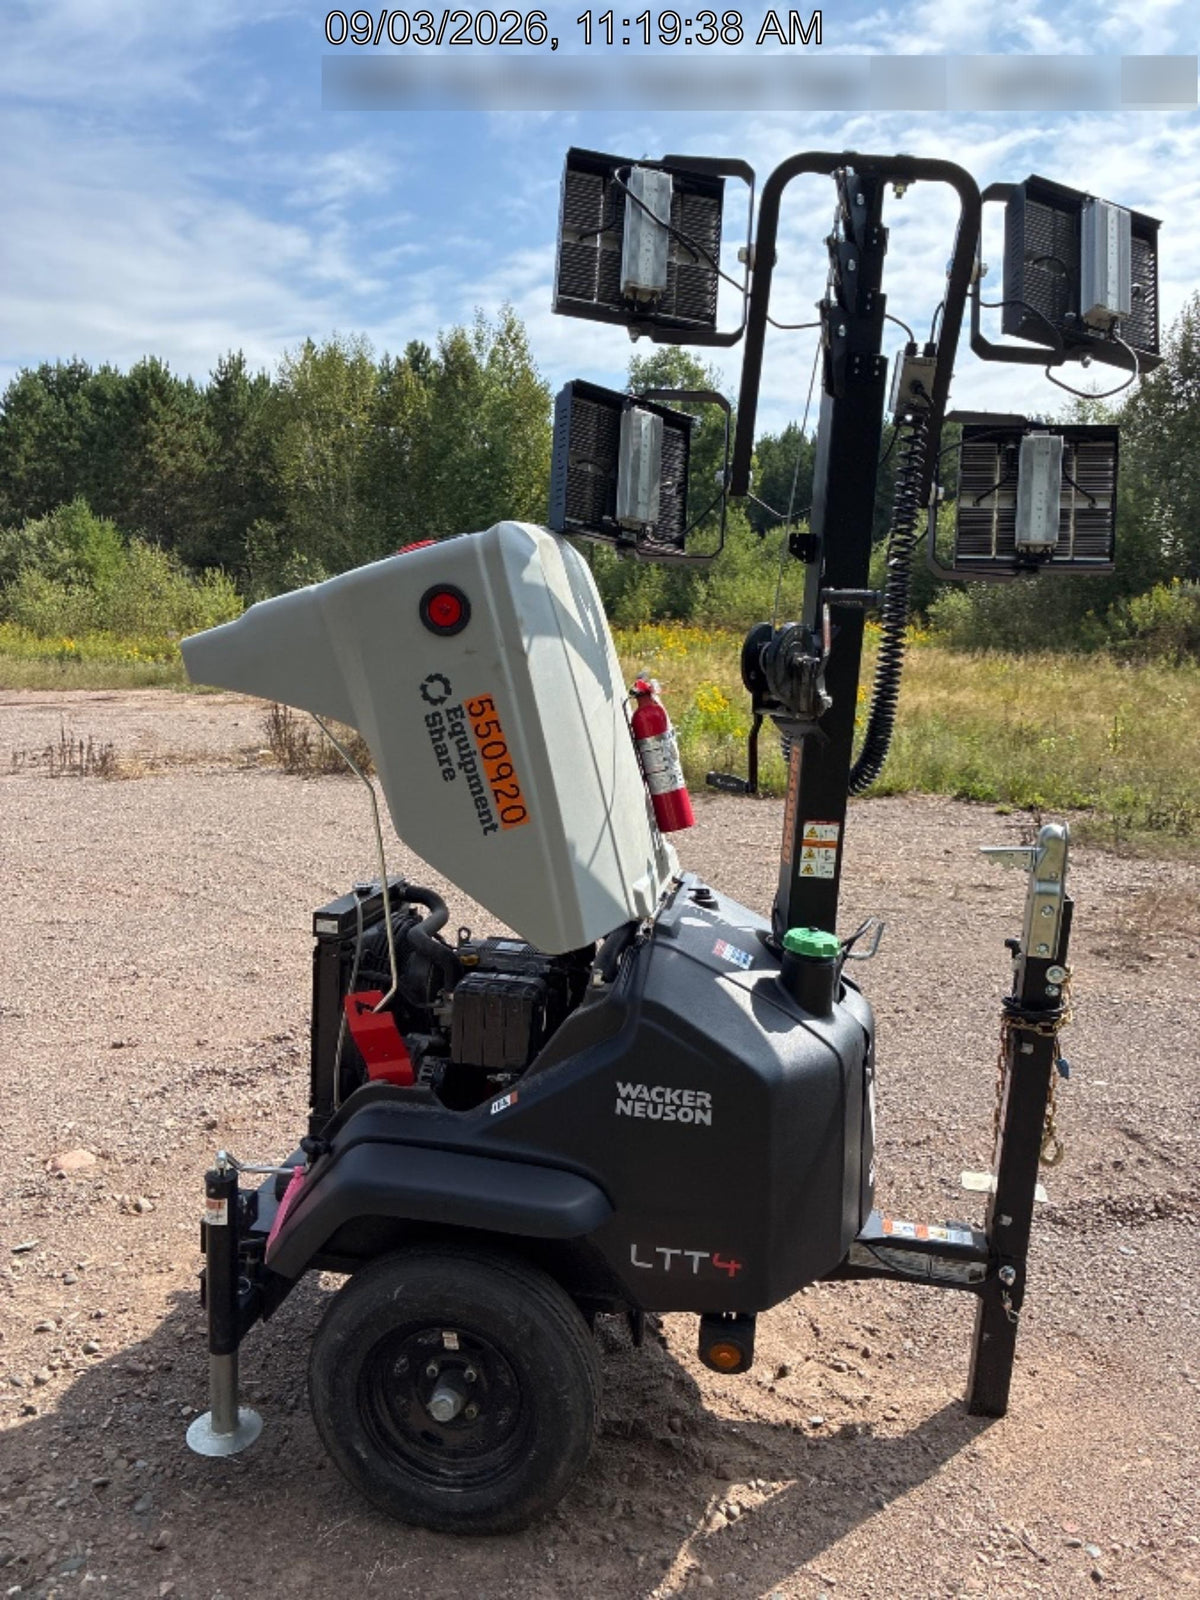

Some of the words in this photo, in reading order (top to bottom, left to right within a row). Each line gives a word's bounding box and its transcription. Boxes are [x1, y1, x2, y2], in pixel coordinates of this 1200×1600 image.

[424, 711, 455, 782] Share
[446, 704, 498, 836] Equipment
[467, 698, 527, 825] 550920
[615, 1098, 712, 1126] NEUSON
[616, 1081, 712, 1108] WACKER
[630, 1243, 742, 1278] LTT4
